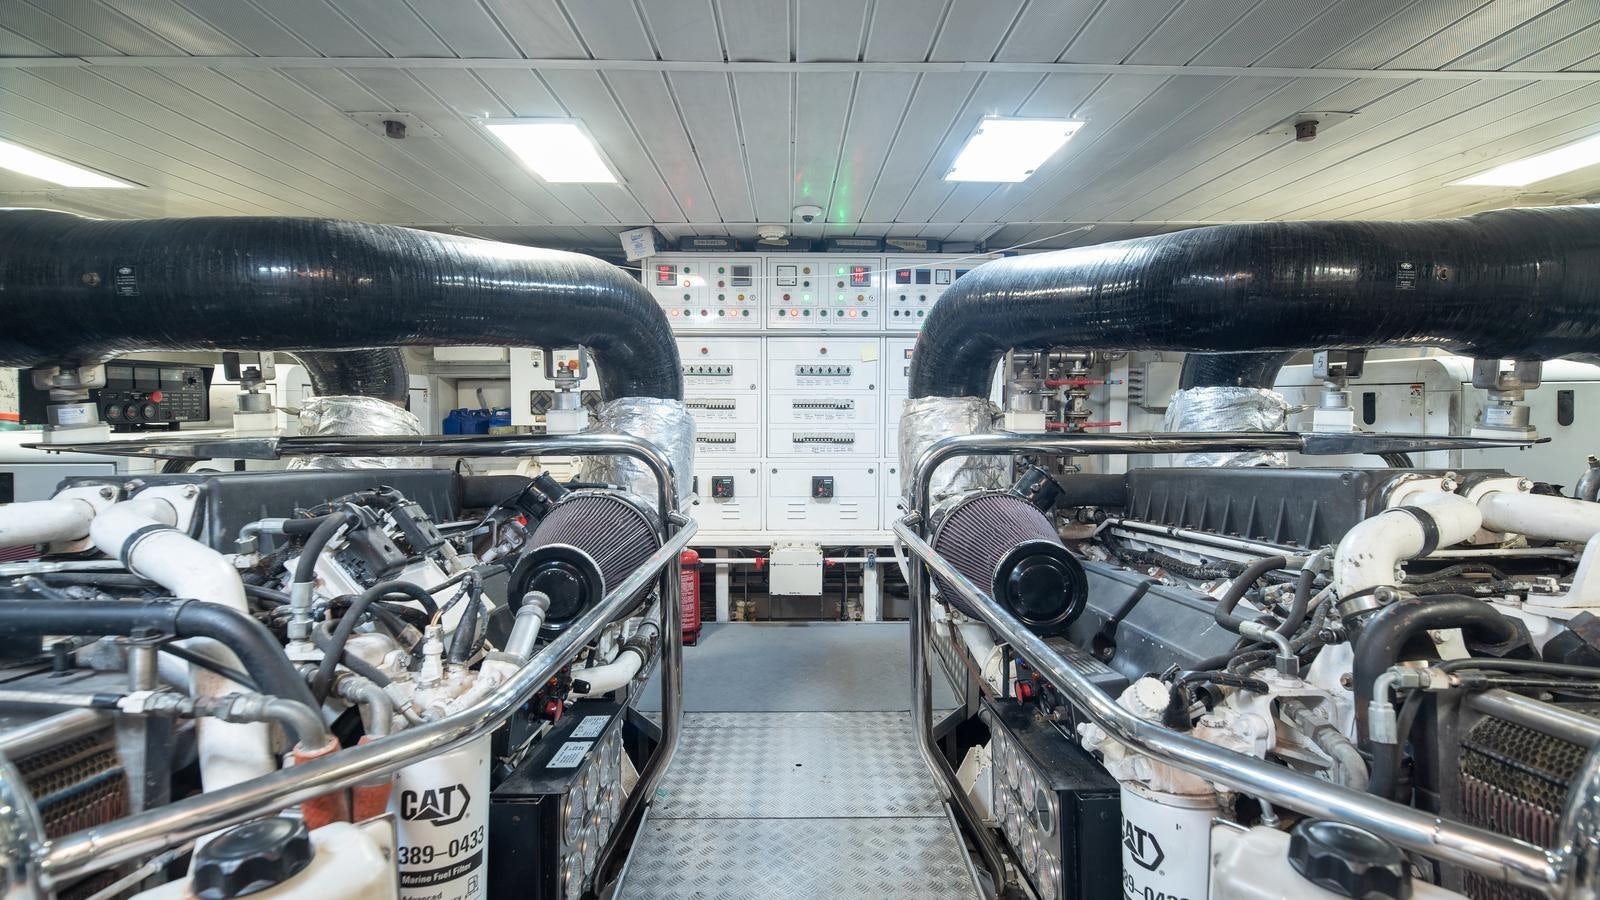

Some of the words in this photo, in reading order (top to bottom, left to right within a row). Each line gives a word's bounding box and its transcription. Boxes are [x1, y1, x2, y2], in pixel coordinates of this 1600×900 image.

[401, 785, 456, 821] CAT
[402, 875, 432, 884] Marine
[433, 869, 452, 880] Fuel
[453, 862, 472, 875] Filter
